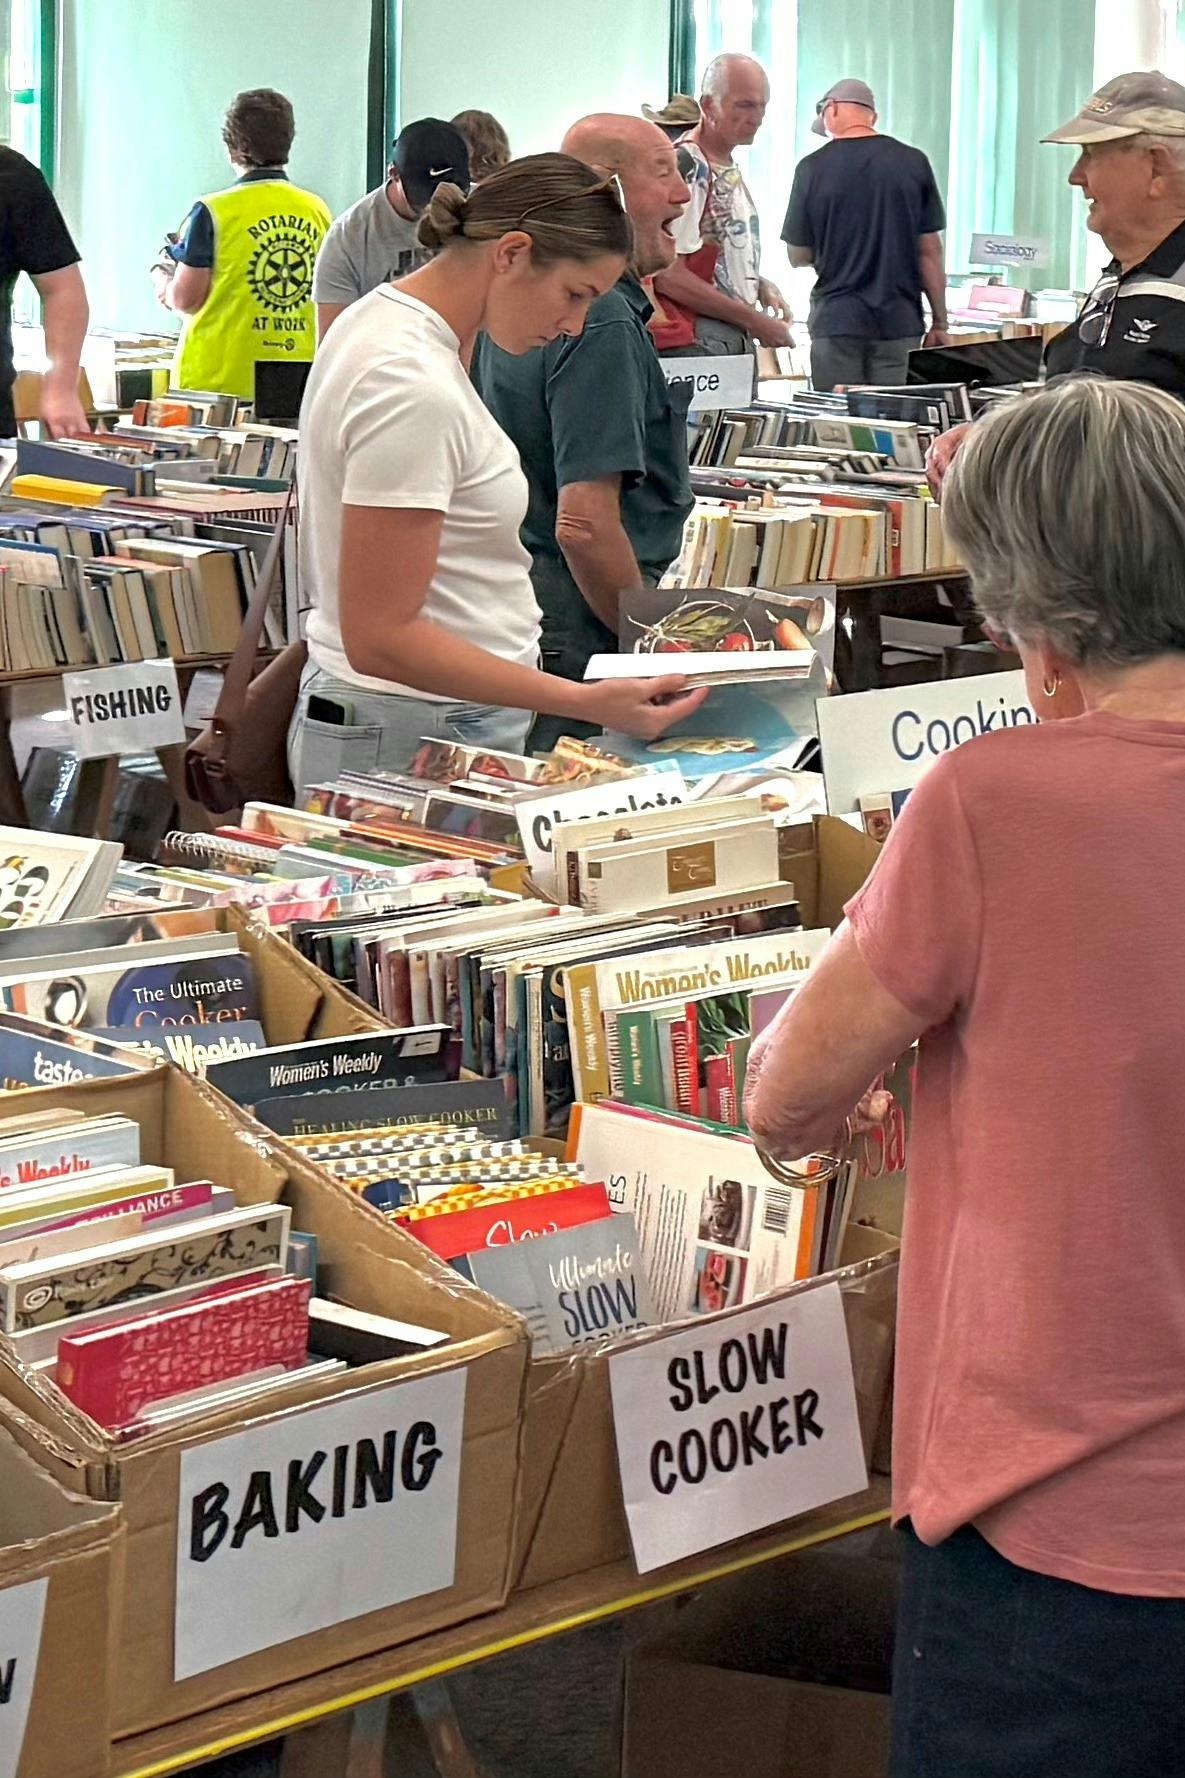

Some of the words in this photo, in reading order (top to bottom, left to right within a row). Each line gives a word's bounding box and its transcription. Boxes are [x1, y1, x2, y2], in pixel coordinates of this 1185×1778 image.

[252, 317, 268, 330] AT
[71, 684, 172, 725] FISHING
[892, 697, 1040, 761] Cookin
[132, 987, 165, 1004] The
[170, 978, 244, 999] Ultimate
[269, 1060, 329, 1087] Women's
[332, 1052, 383, 1077] Weekly
[429, 1107, 497, 1122] COOKER
[558, 1275, 637, 1338] SLOW
[667, 1322, 788, 1412] SLOW
[650, 1388, 824, 1495] COOKER
[190, 1421, 443, 1562] BAKING
